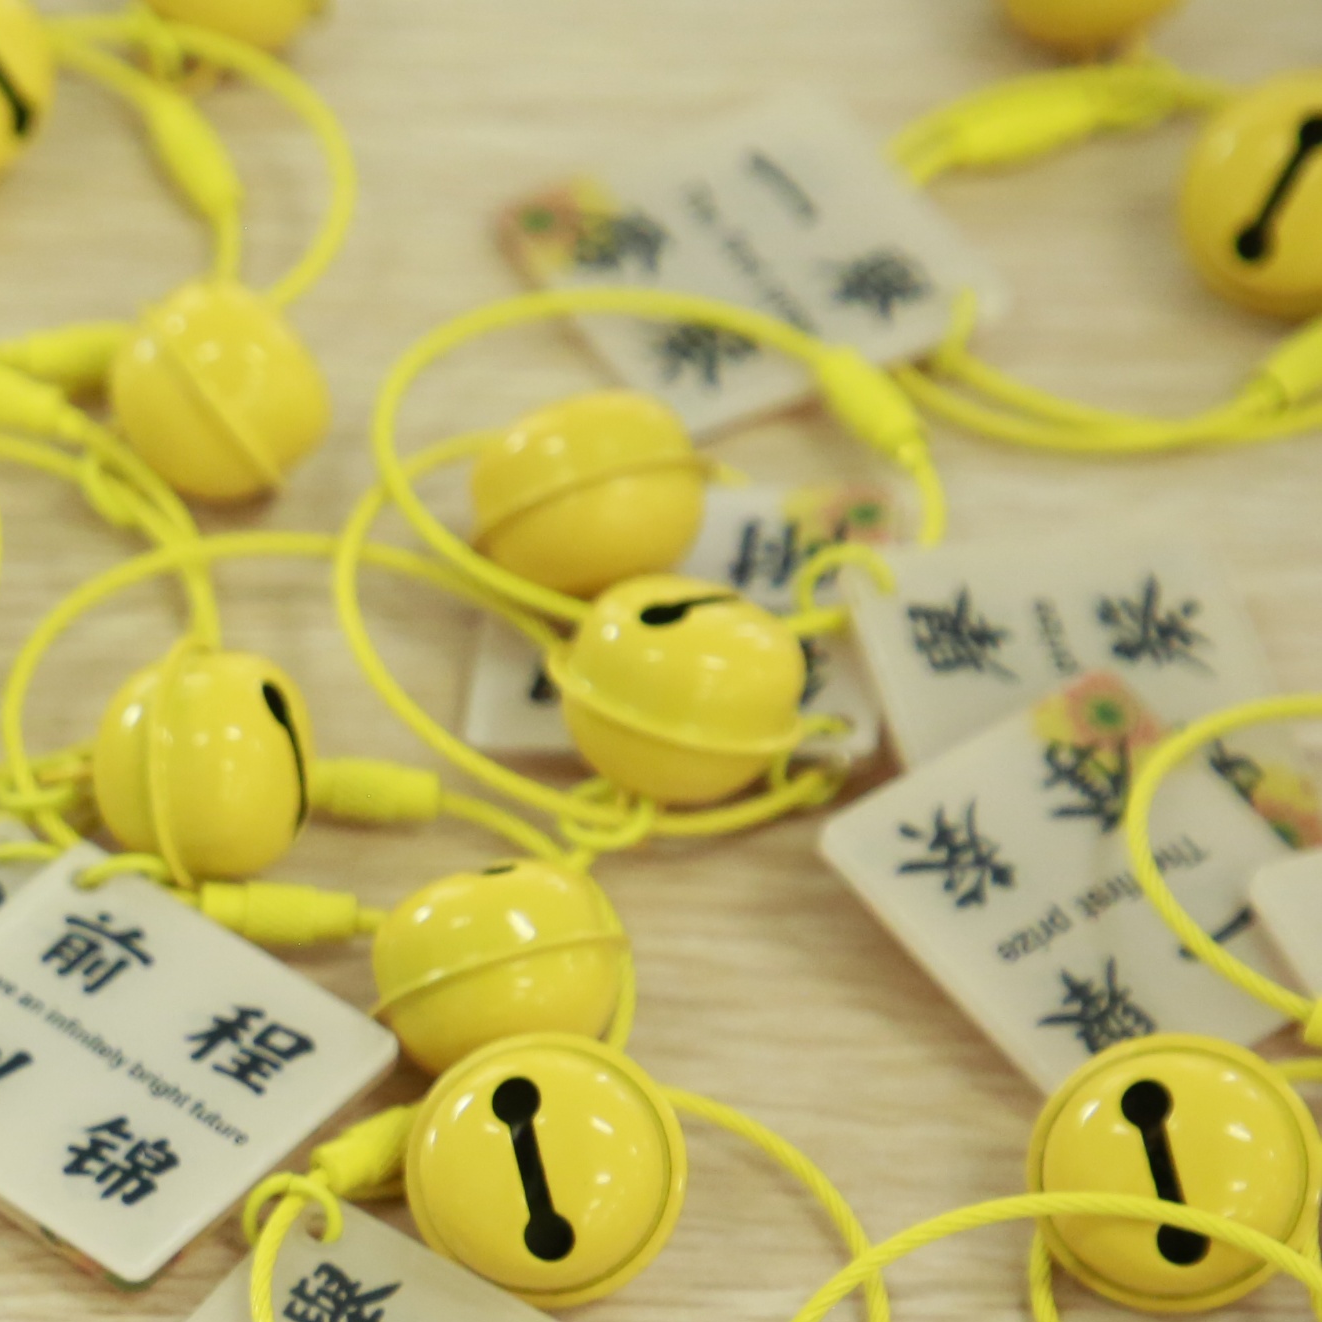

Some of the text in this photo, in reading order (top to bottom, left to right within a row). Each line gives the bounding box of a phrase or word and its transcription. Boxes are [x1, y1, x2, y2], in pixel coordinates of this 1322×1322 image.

[18, 991, 47, 1014] an
[45, 1006, 128, 1071] infinitely
[128, 1056, 192, 1109] bright
[189, 1099, 250, 1147] future
